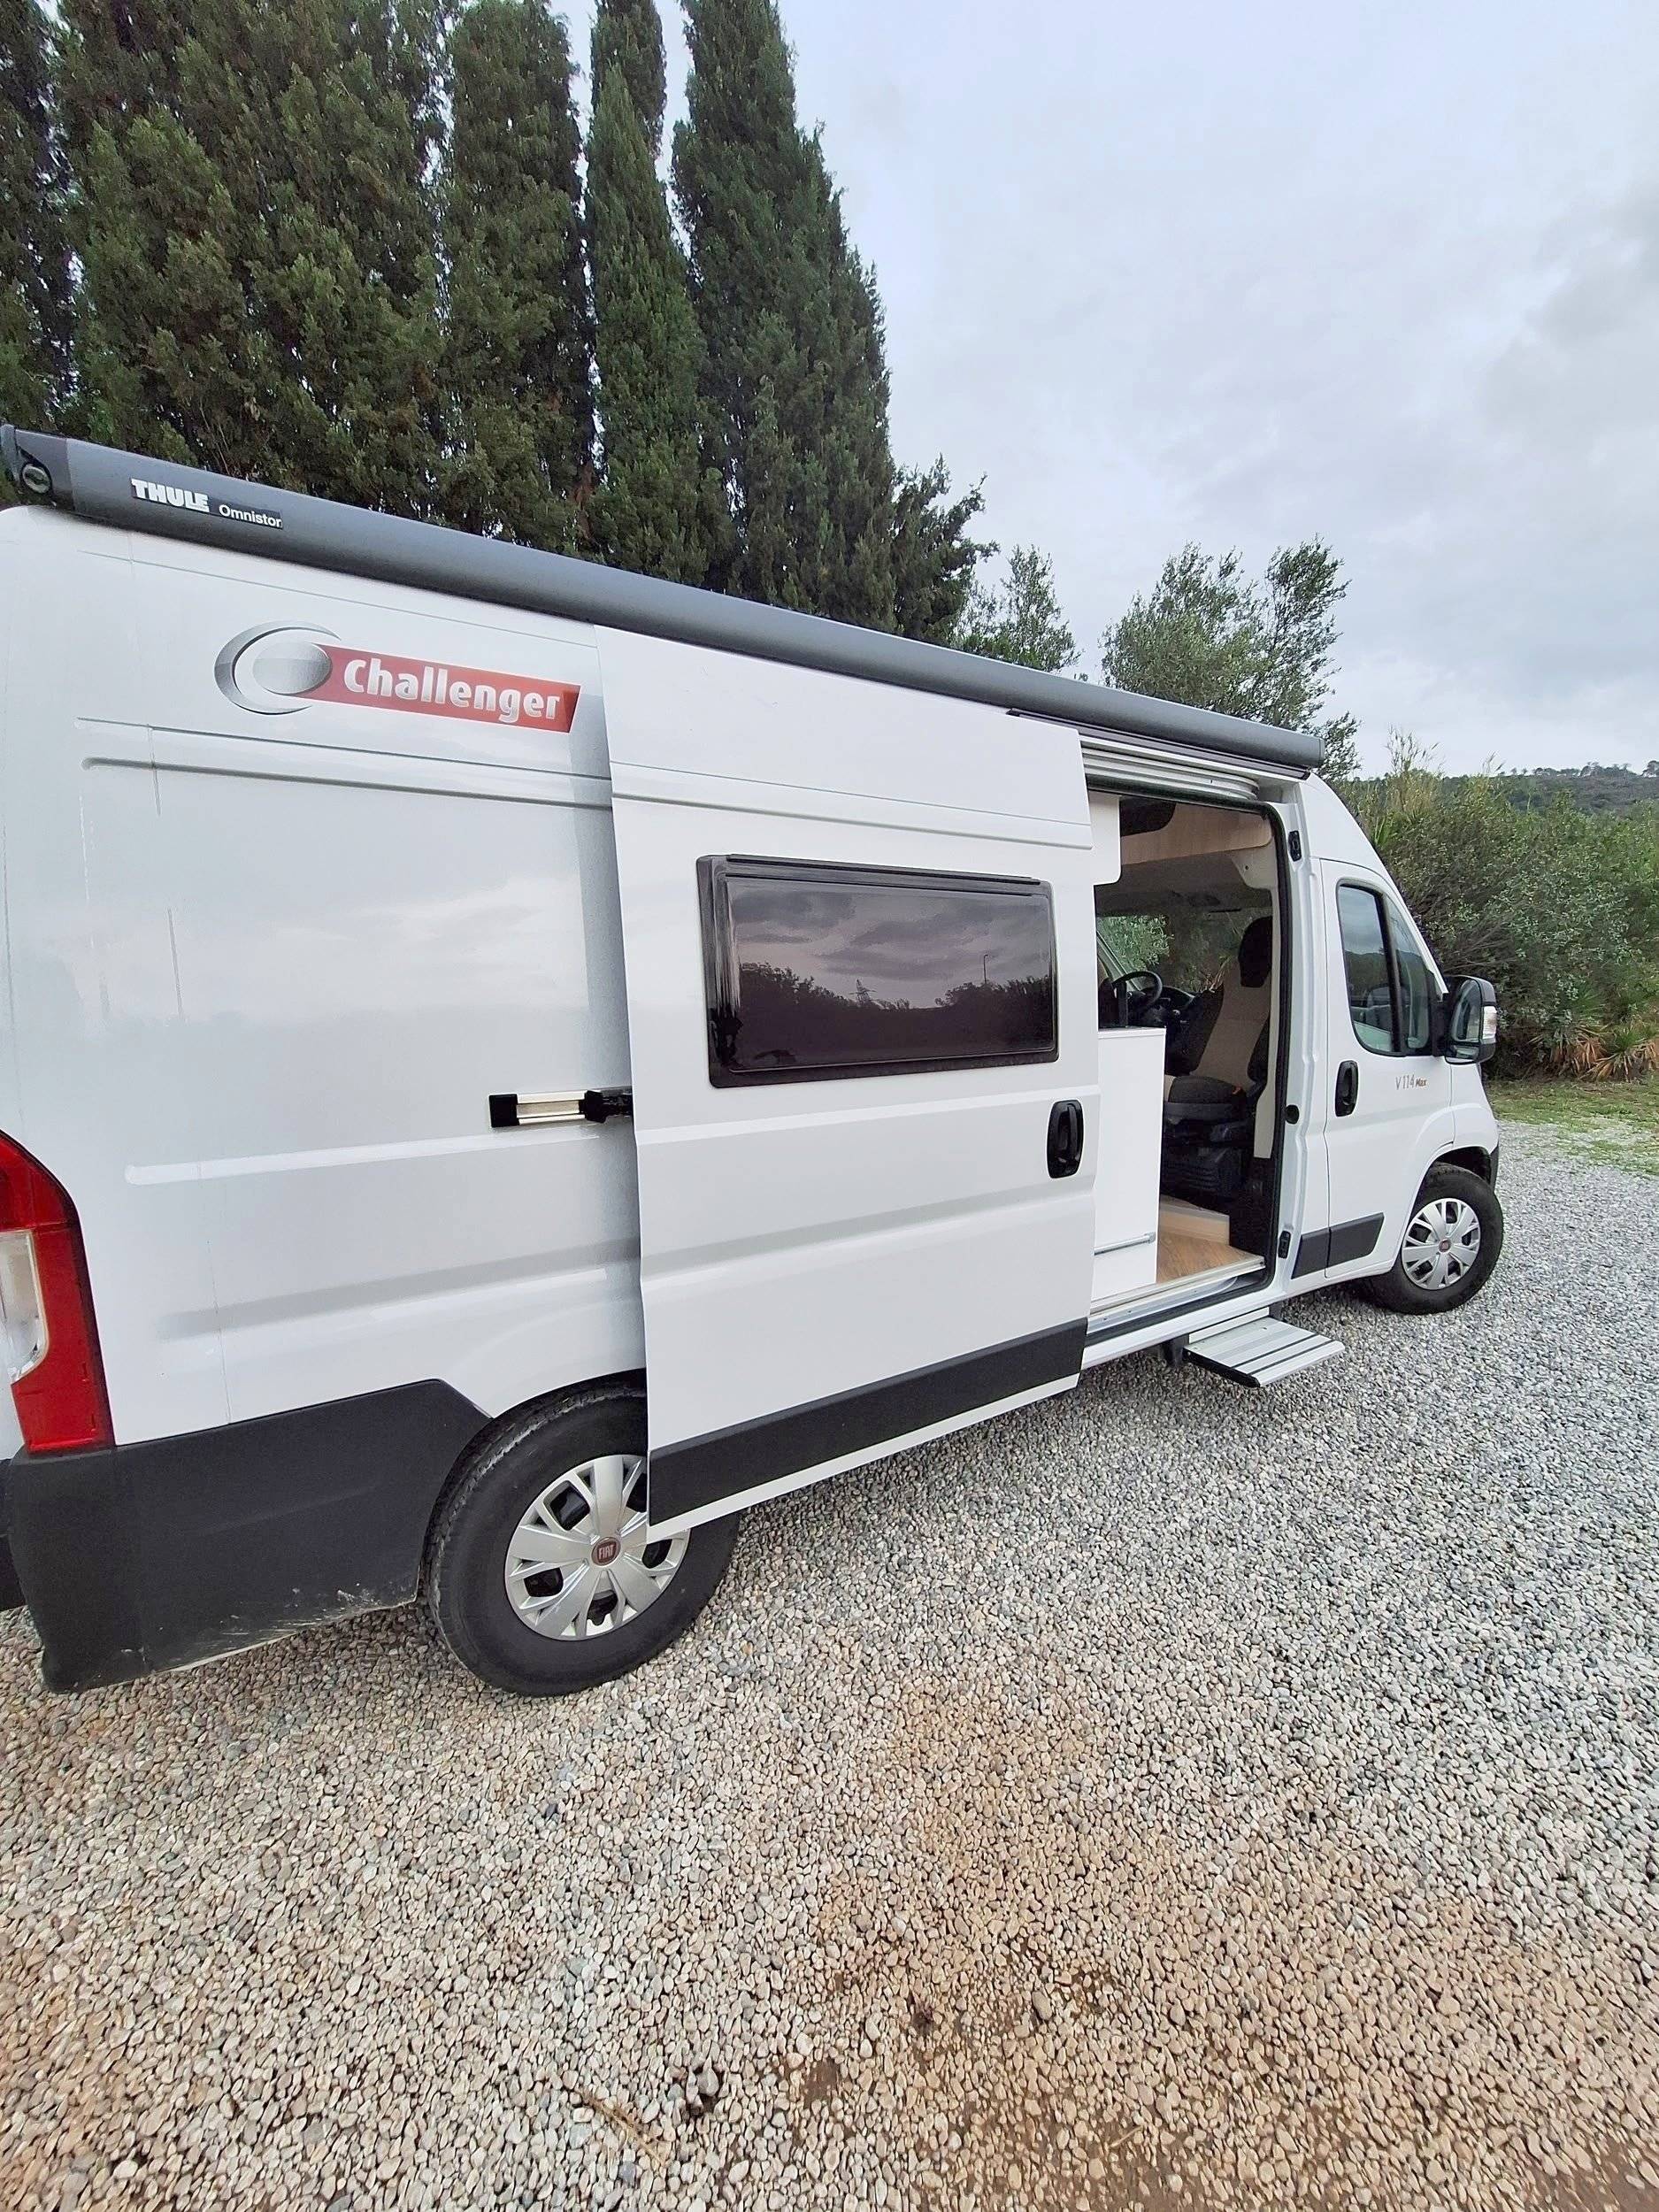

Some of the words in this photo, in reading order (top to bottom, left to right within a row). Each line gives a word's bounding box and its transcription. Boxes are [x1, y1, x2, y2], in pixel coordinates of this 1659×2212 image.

[130, 479, 209, 512] THULE
[219, 504, 282, 528] Omnistor
[343, 657, 561, 724] Challenger
[598, 1545, 614, 1560] FIAT
